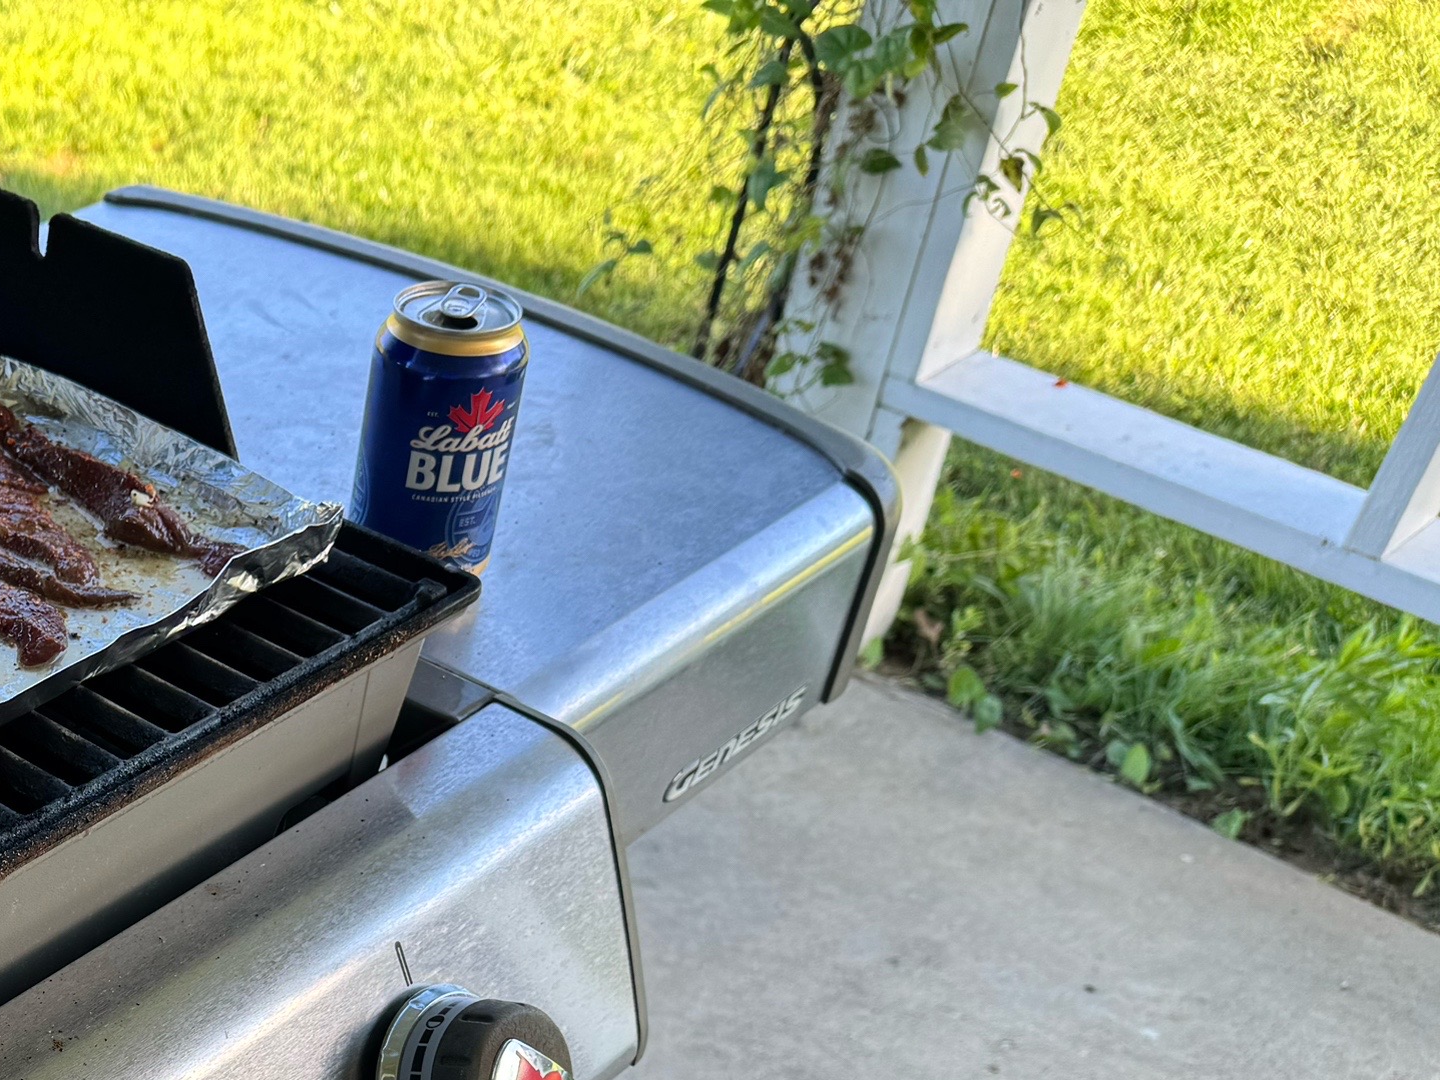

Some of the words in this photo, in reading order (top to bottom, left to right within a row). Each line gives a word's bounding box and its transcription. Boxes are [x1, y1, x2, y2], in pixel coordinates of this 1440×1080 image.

[410, 416, 515, 452] Labatt
[405, 443, 509, 493] BLUE
[411, 493, 448, 503] CANADIAN
